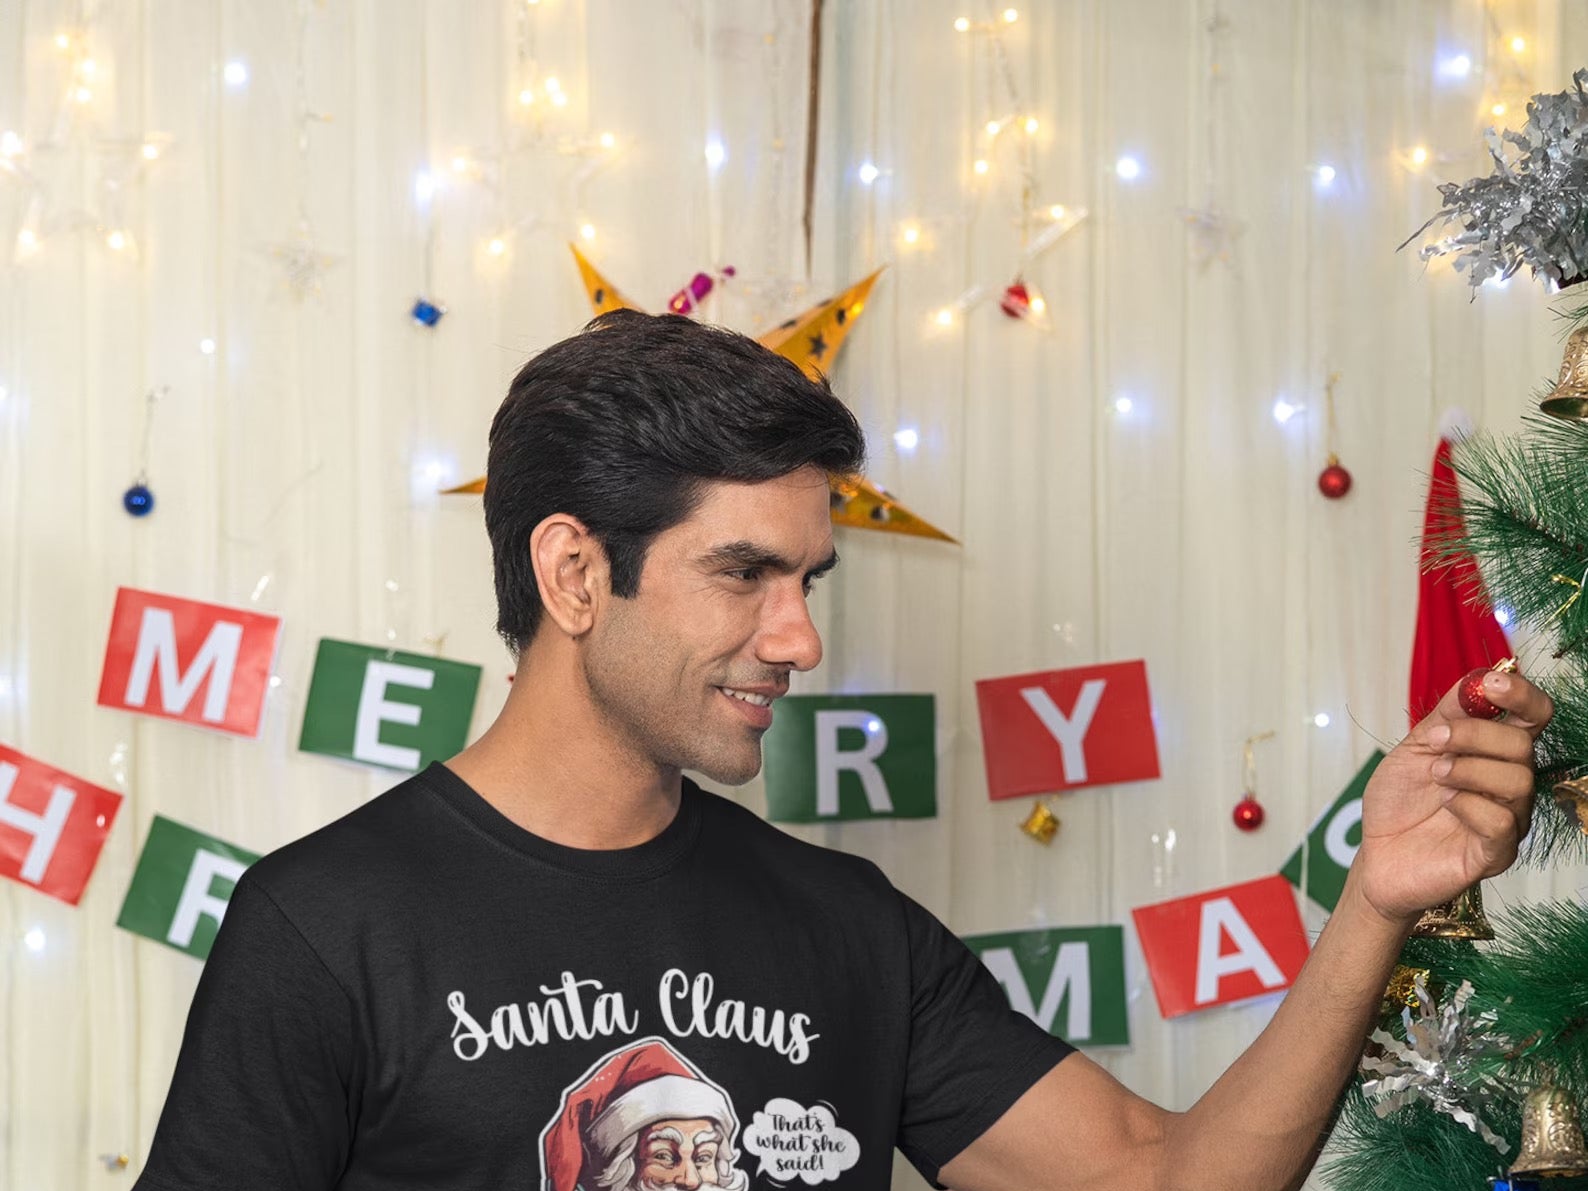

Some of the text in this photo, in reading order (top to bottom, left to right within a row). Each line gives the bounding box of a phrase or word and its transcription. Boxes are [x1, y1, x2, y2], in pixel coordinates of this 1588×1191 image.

[447, 968, 821, 1065] Santa Claus
[767, 1112, 826, 1133] That's
[756, 1134, 847, 1154] what she
[776, 1154, 825, 1172] said!
